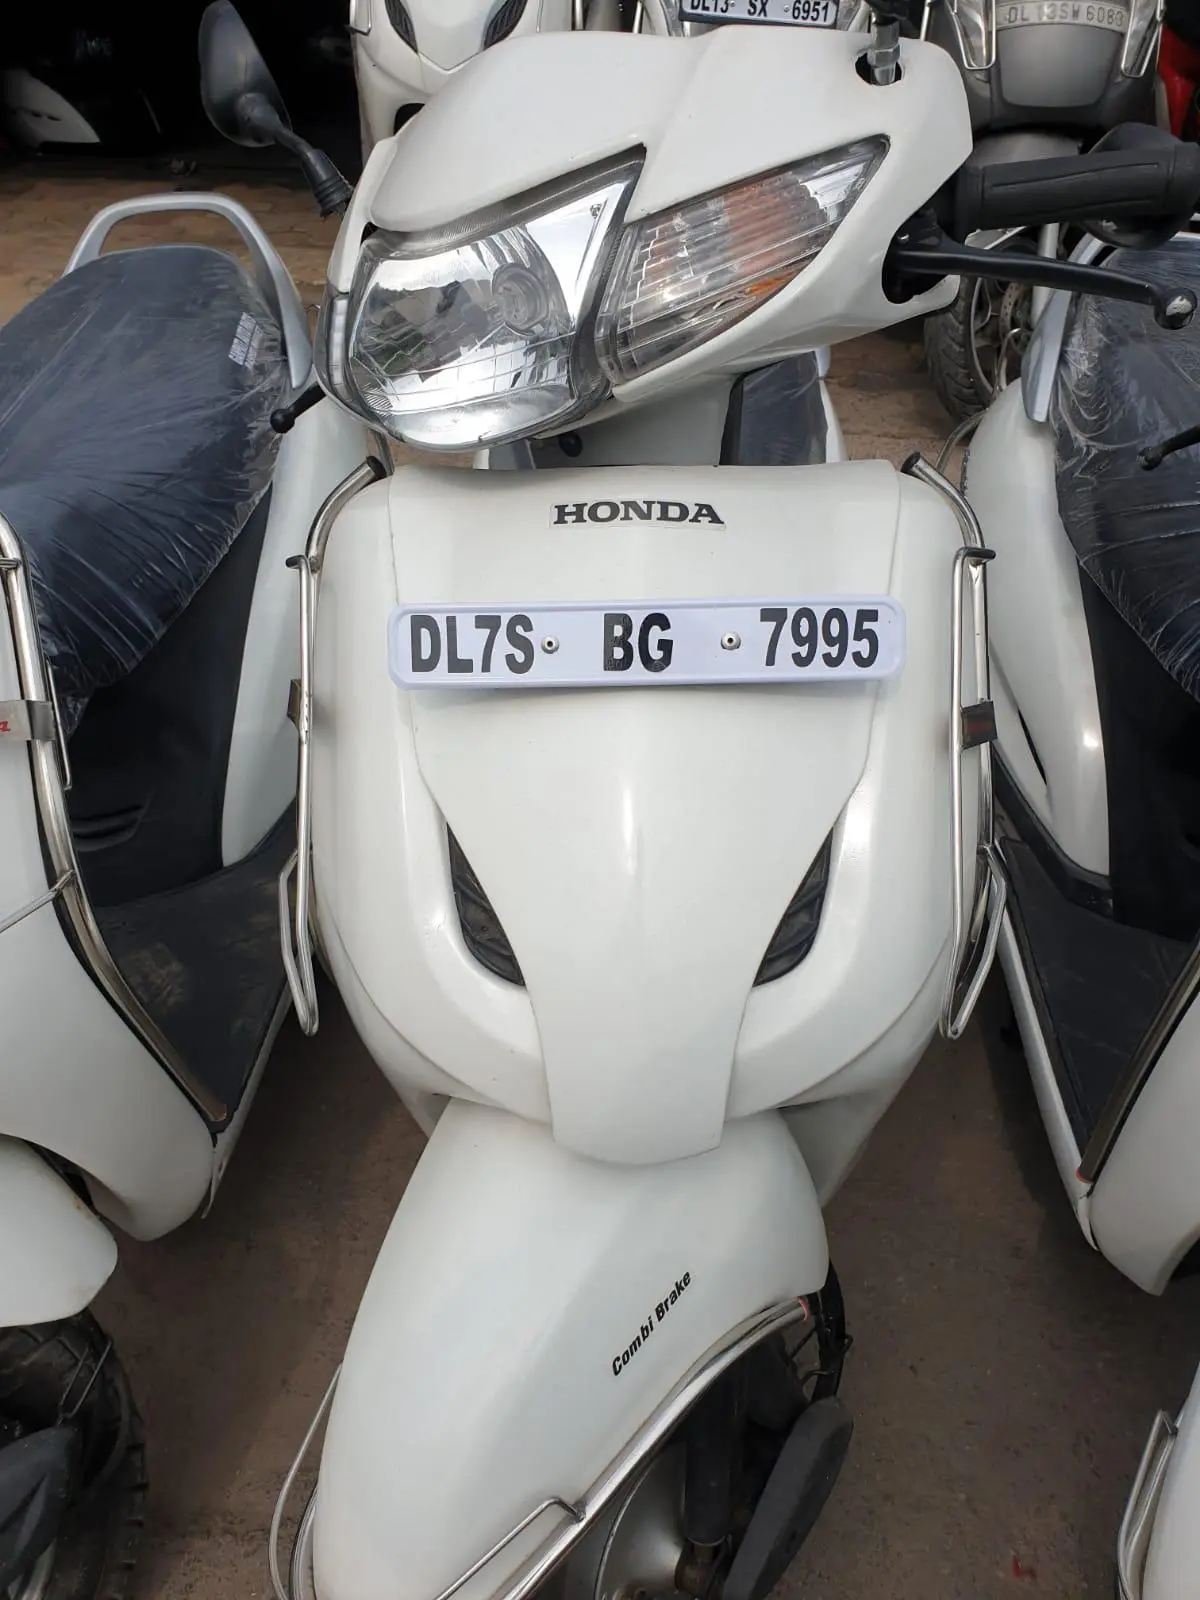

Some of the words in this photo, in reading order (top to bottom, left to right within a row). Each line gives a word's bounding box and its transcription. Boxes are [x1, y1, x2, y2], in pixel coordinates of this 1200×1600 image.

[747, 0, 768, 17] SX
[792, 1, 829, 22] 6951
[553, 500, 725, 525] HONDA
[410, 614, 535, 674] DL7S
[603, 612, 673, 672] BG
[759, 607, 879, 669] 7995
[612, 1315, 654, 1376] Combi
[655, 1271, 691, 1322] Brake
